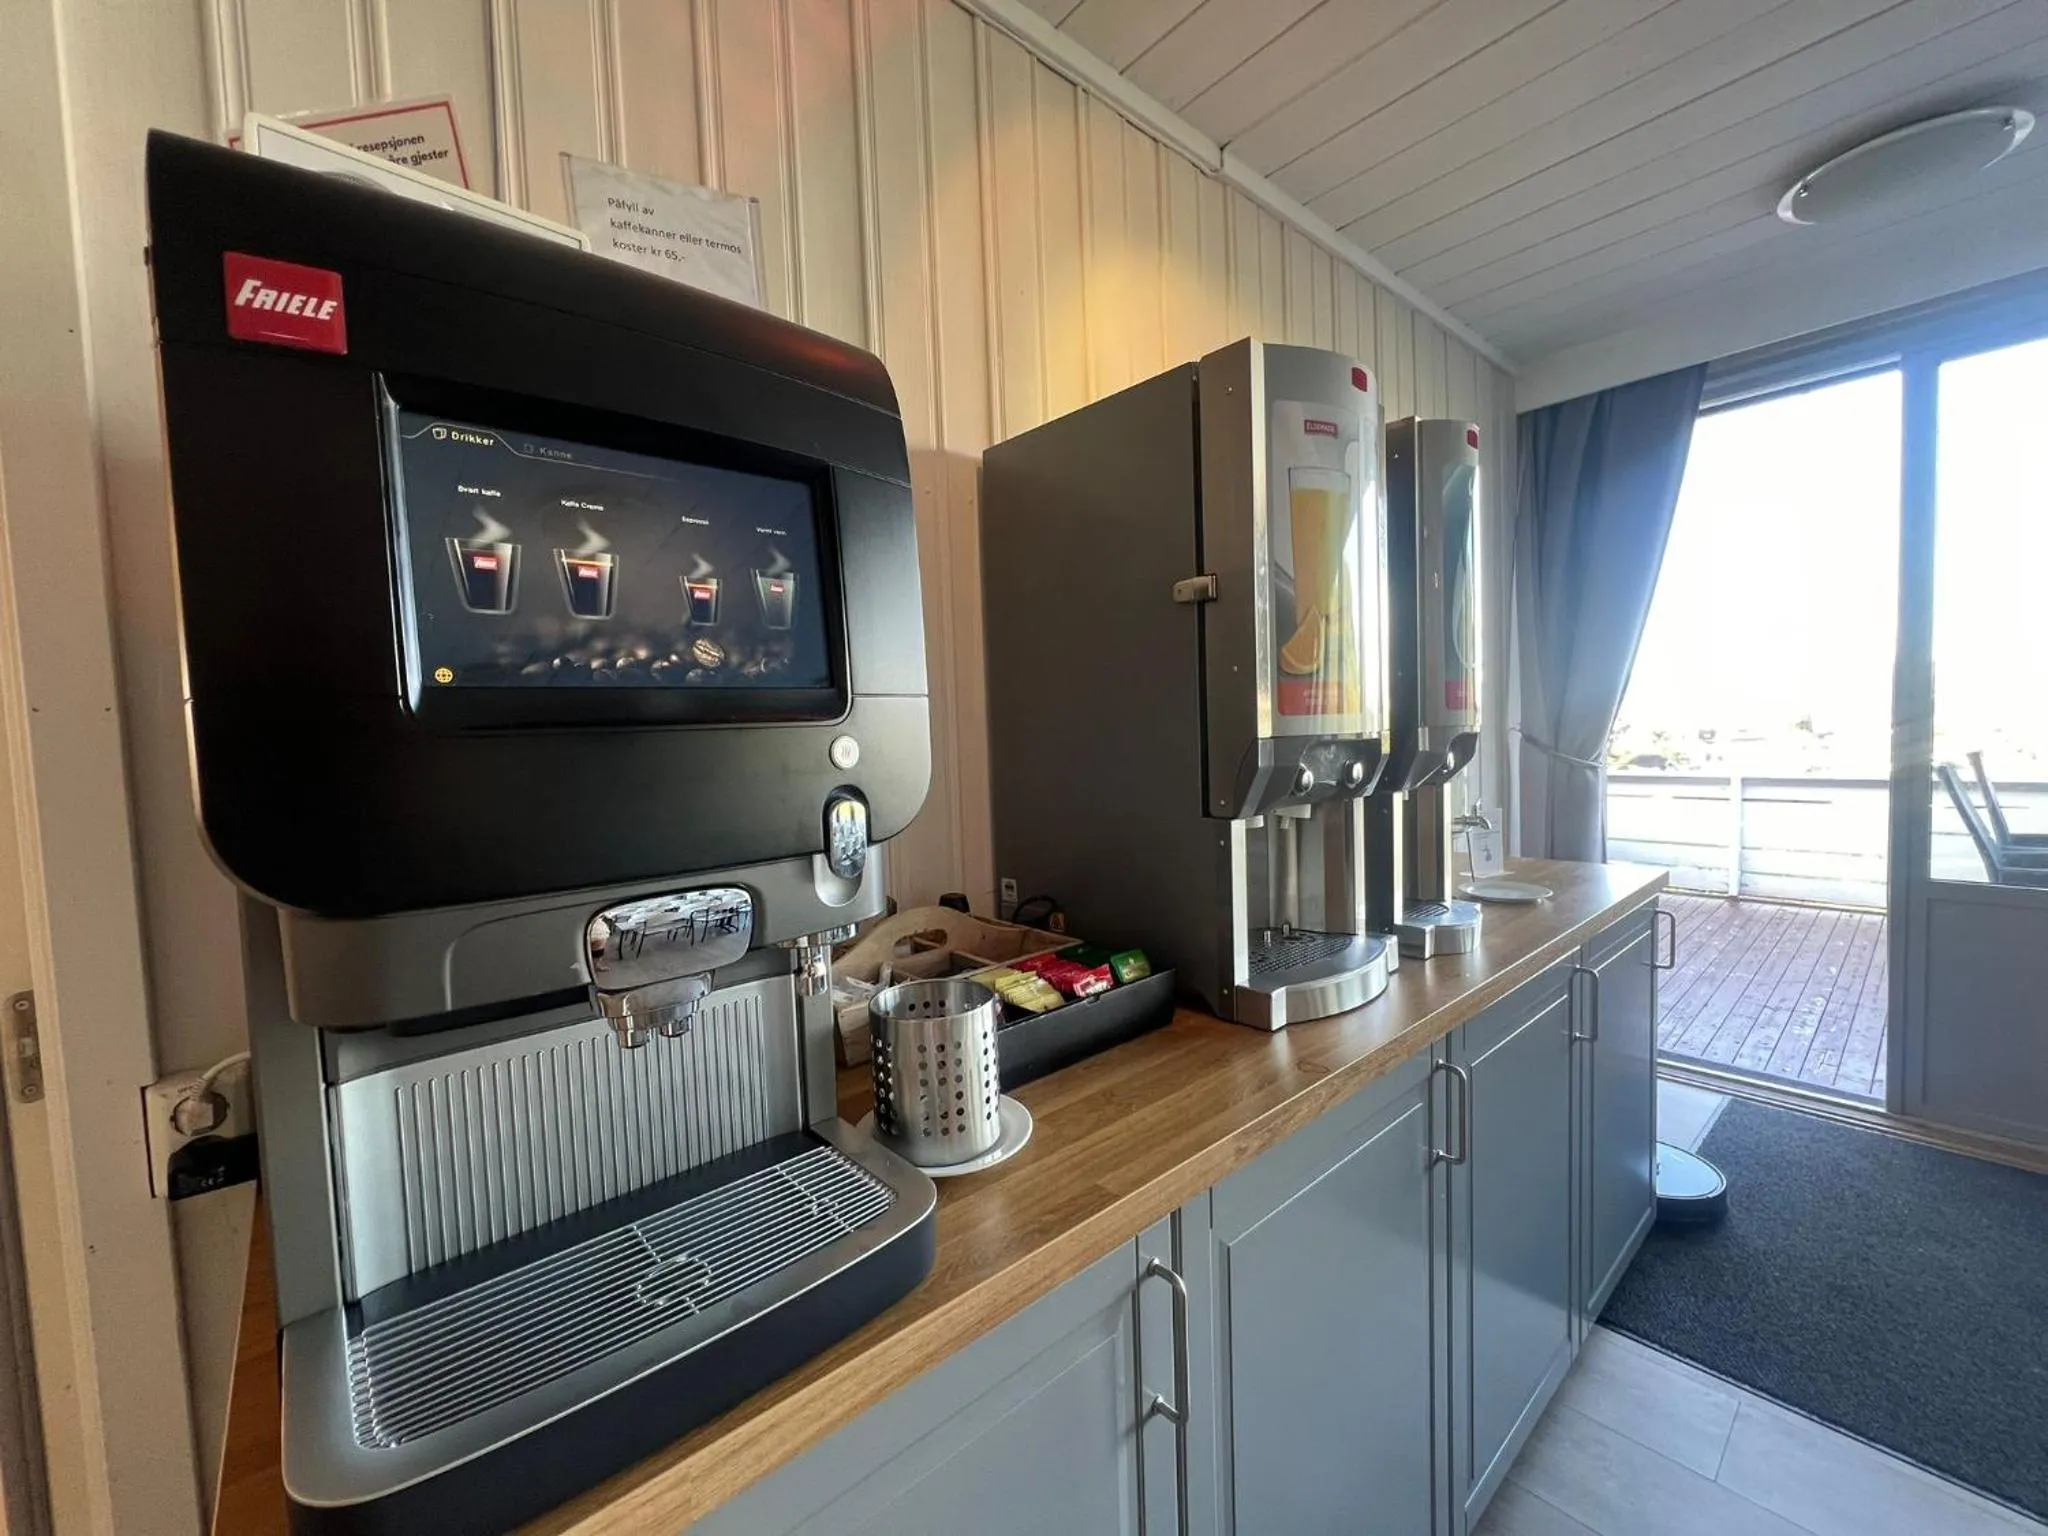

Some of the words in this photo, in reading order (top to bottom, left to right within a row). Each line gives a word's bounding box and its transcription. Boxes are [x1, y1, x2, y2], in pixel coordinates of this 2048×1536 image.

[356, 135, 425, 153] resepsjonen
[386, 154, 408, 165] åre
[410, 149, 449, 166] gjester
[608, 197, 639, 213] Påfyll
[642, 206, 655, 215] av
[610, 218, 676, 240] kaffekanner
[679, 232, 703, 246] eller
[705, 238, 742, 254] termos
[612, 238, 647, 254] koster
[650, 245, 662, 256] kr
[664, 249, 685, 262] 65,-
[234, 278, 338, 320] FRIELE
[451, 431, 494, 446] Drikker
[540, 447, 573, 459] Kanne
